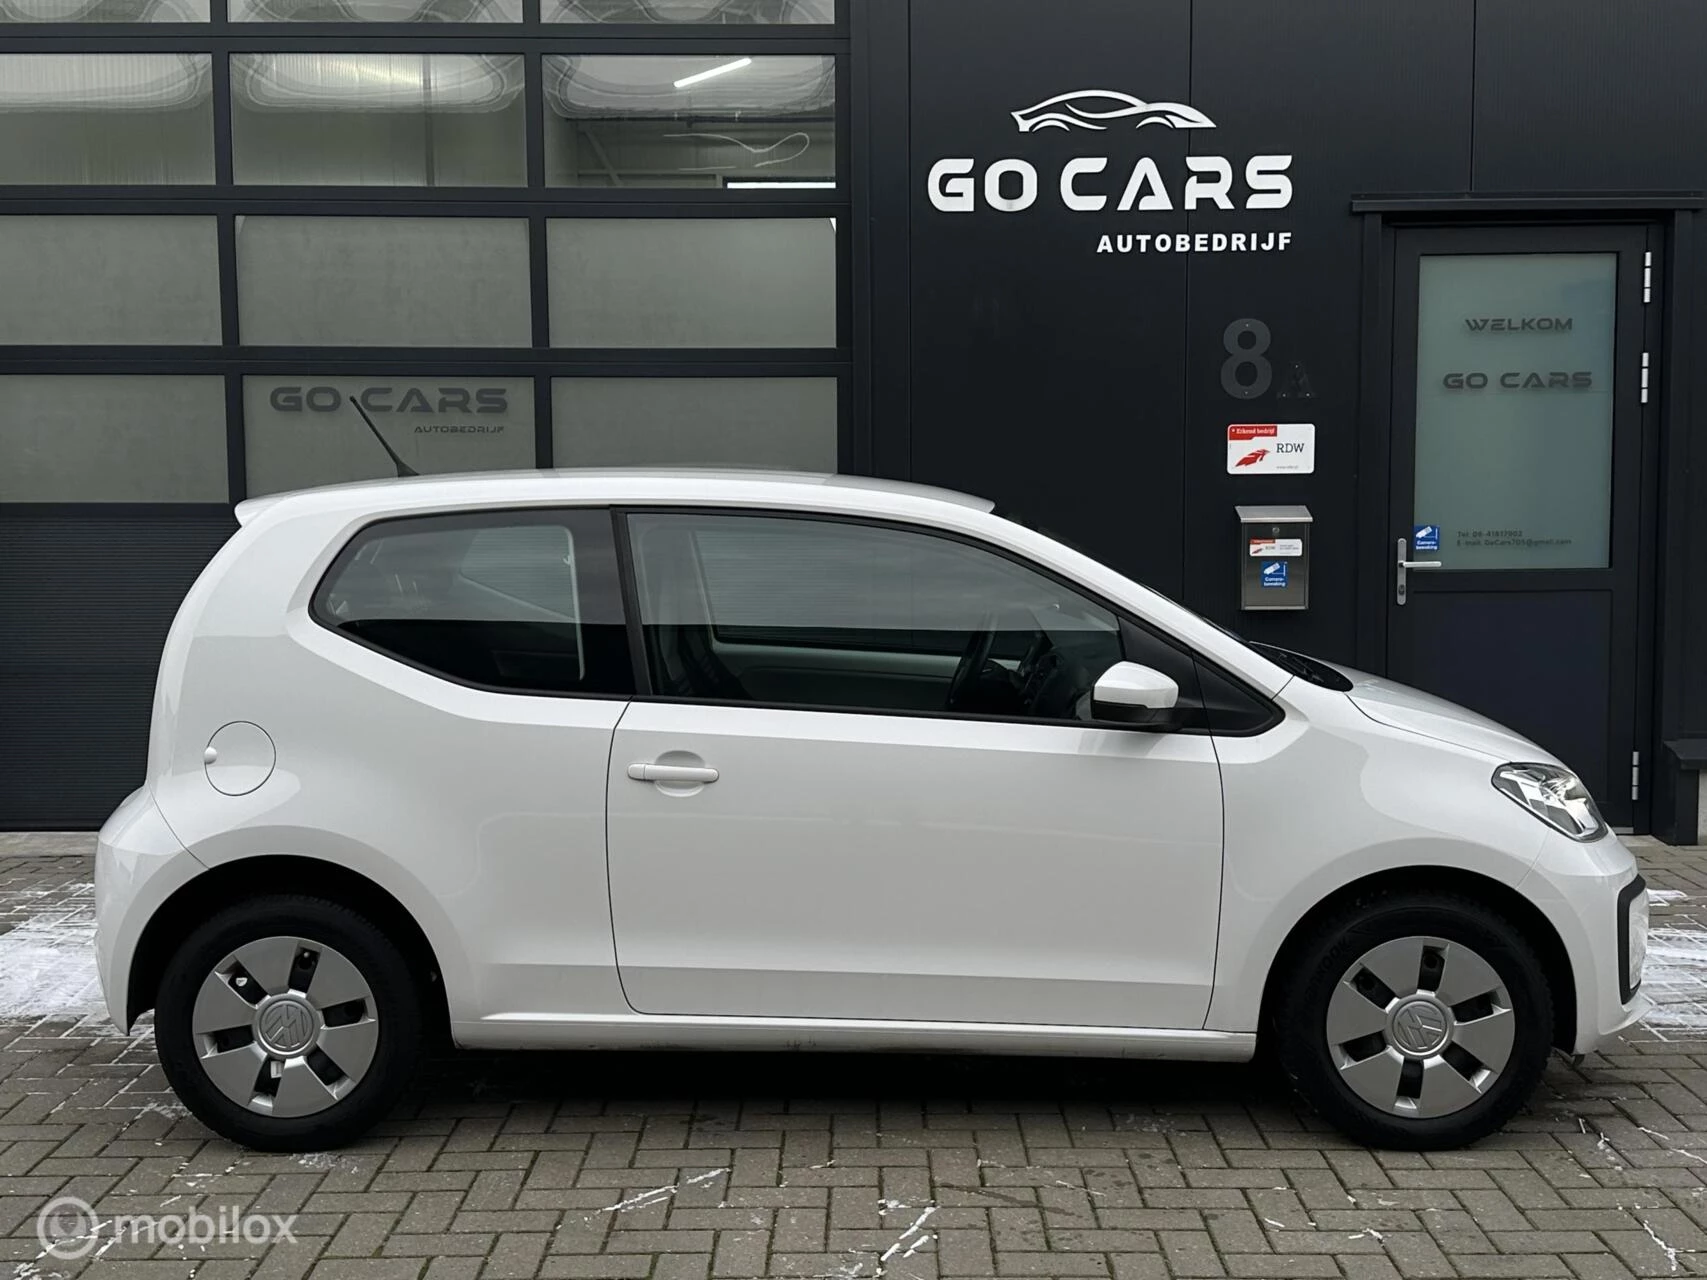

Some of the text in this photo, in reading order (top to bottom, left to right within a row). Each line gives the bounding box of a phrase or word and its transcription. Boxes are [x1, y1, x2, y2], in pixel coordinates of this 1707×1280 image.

[927, 155, 1293, 212] GO CARS
[1097, 232, 1292, 253] AUTOBEDRIJF
[1465, 318, 1573, 332] WELKOM
[1442, 371, 1593, 390] GO CARS
[270, 386, 508, 413] GO CARS
[414, 425, 505, 434] AUTOBEDRIJF
[1276, 443, 1305, 454] RDW
